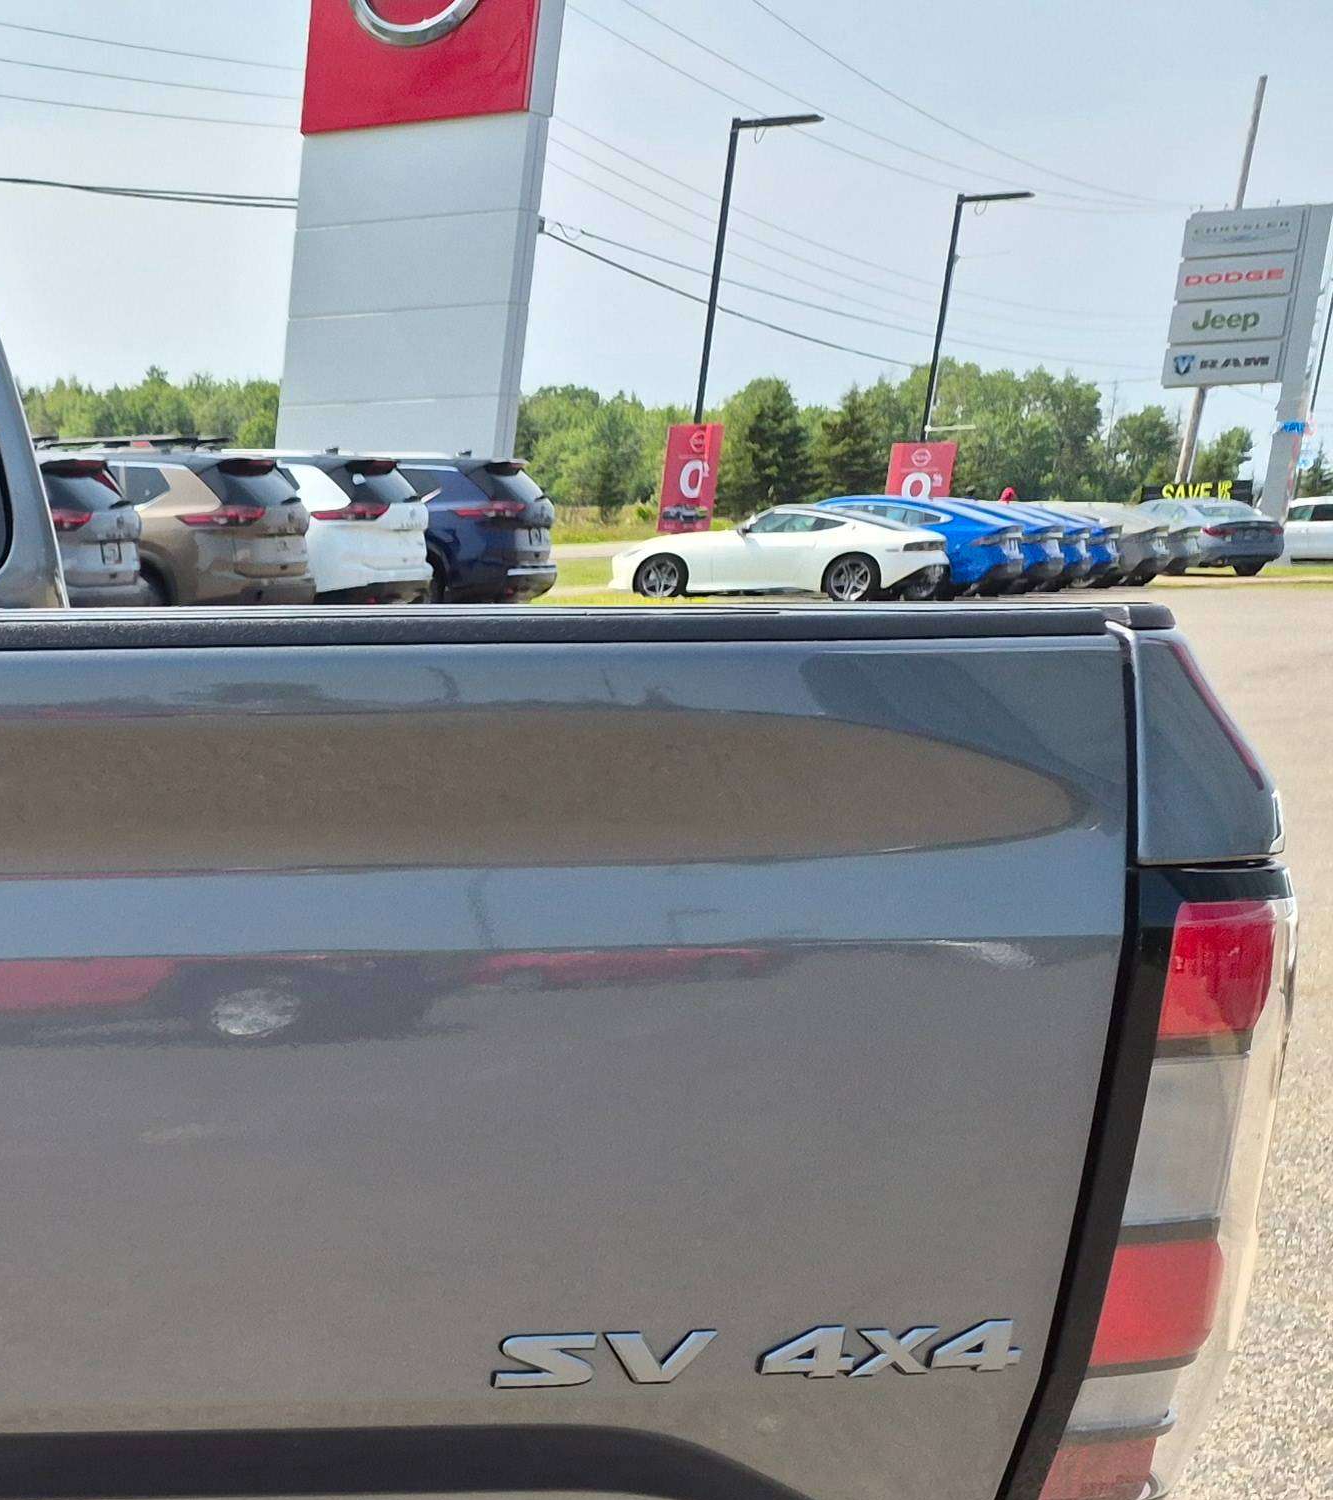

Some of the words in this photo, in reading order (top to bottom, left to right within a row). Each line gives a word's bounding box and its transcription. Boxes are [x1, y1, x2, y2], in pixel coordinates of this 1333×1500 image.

[1184, 268, 1284, 286] DODGE
[1192, 309, 1260, 332] Jeep
[1199, 356, 1270, 369] RAM
[1162, 482, 1212, 500] SAVE
[493, 1330, 719, 1388] SV
